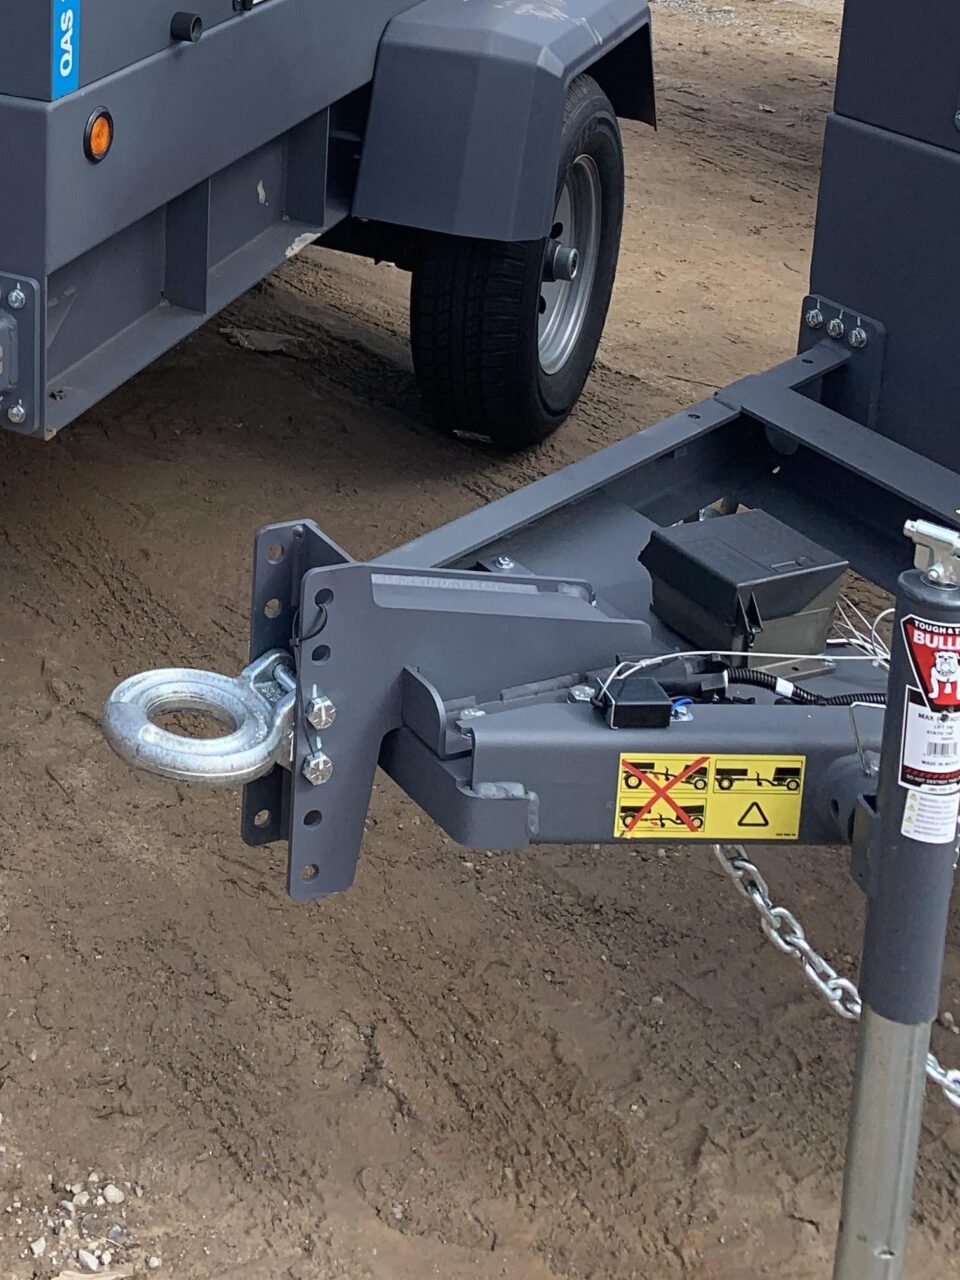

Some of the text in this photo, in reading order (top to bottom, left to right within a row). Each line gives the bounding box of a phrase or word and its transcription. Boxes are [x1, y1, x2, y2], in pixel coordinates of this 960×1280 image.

[60, 9, 74, 77] QAS
[914, 620, 947, 634] TOUGH
[918, 712, 933, 721] MAX
